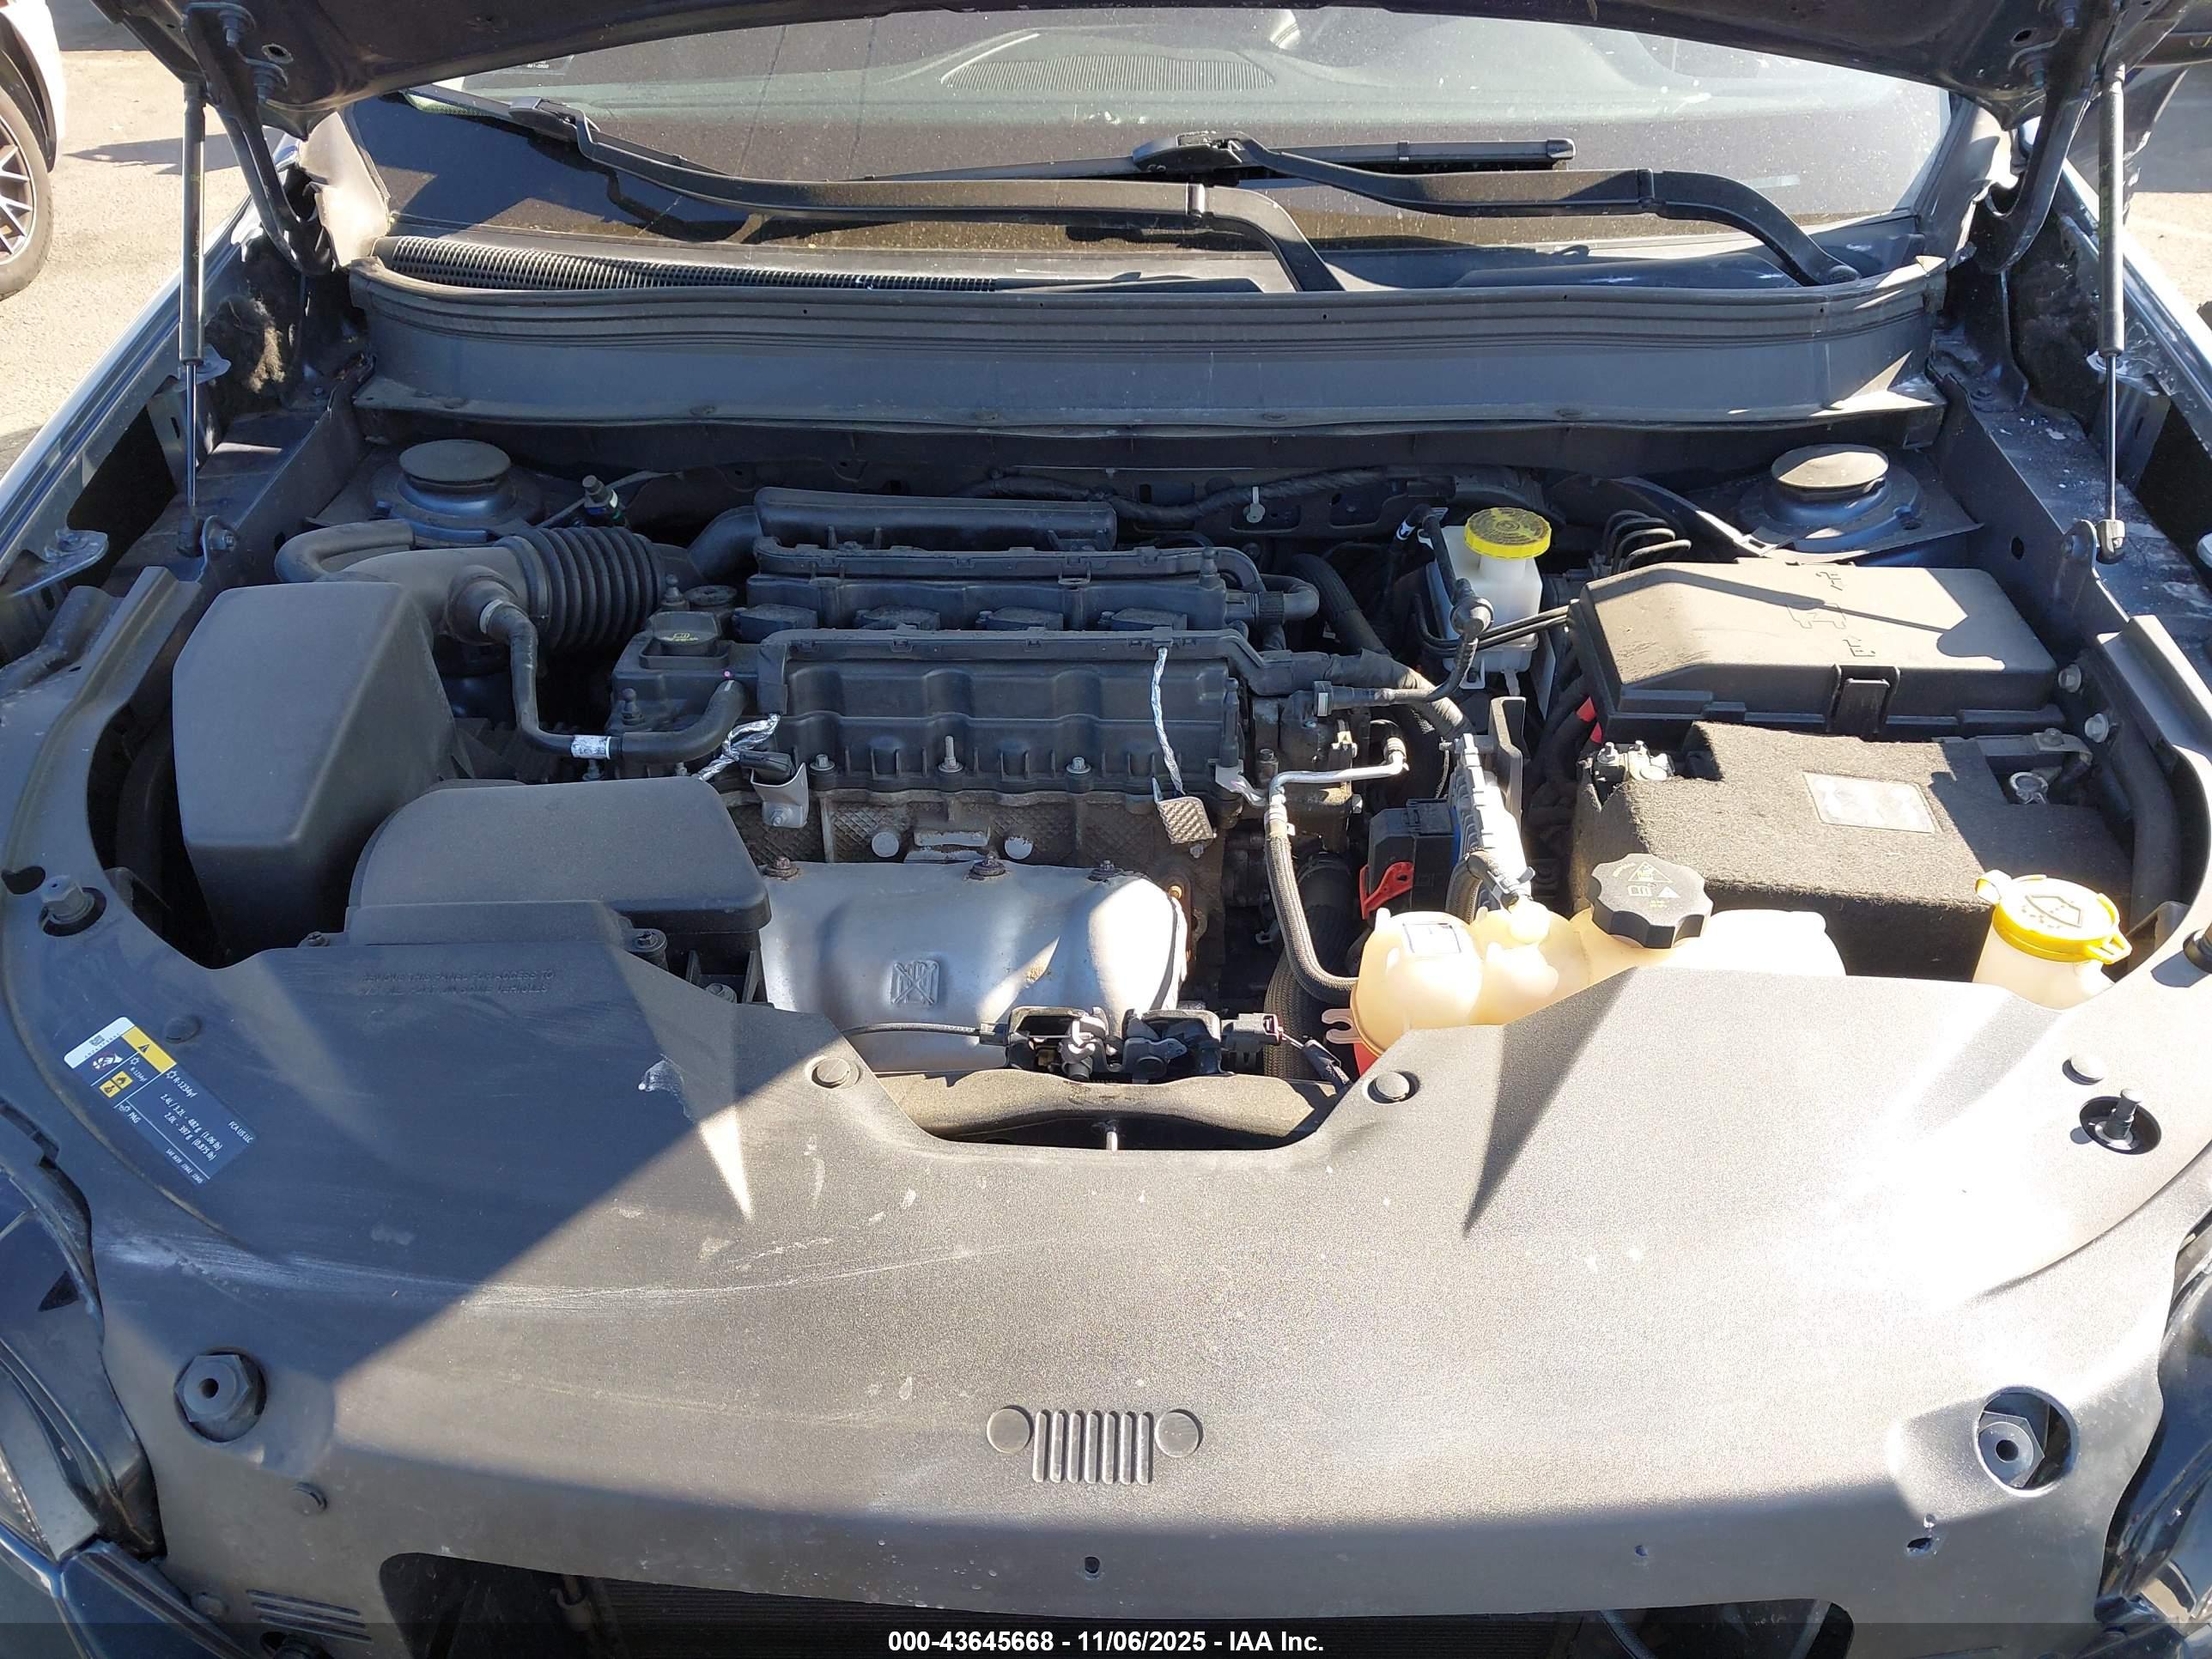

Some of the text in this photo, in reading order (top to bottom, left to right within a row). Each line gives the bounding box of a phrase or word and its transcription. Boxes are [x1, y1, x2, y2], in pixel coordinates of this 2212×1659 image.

[126, 1111, 141, 1123] PAG
[178, 1125, 191, 1135] 397
[228, 1121, 239, 1131] FCA
[236, 1127, 246, 1136] US
